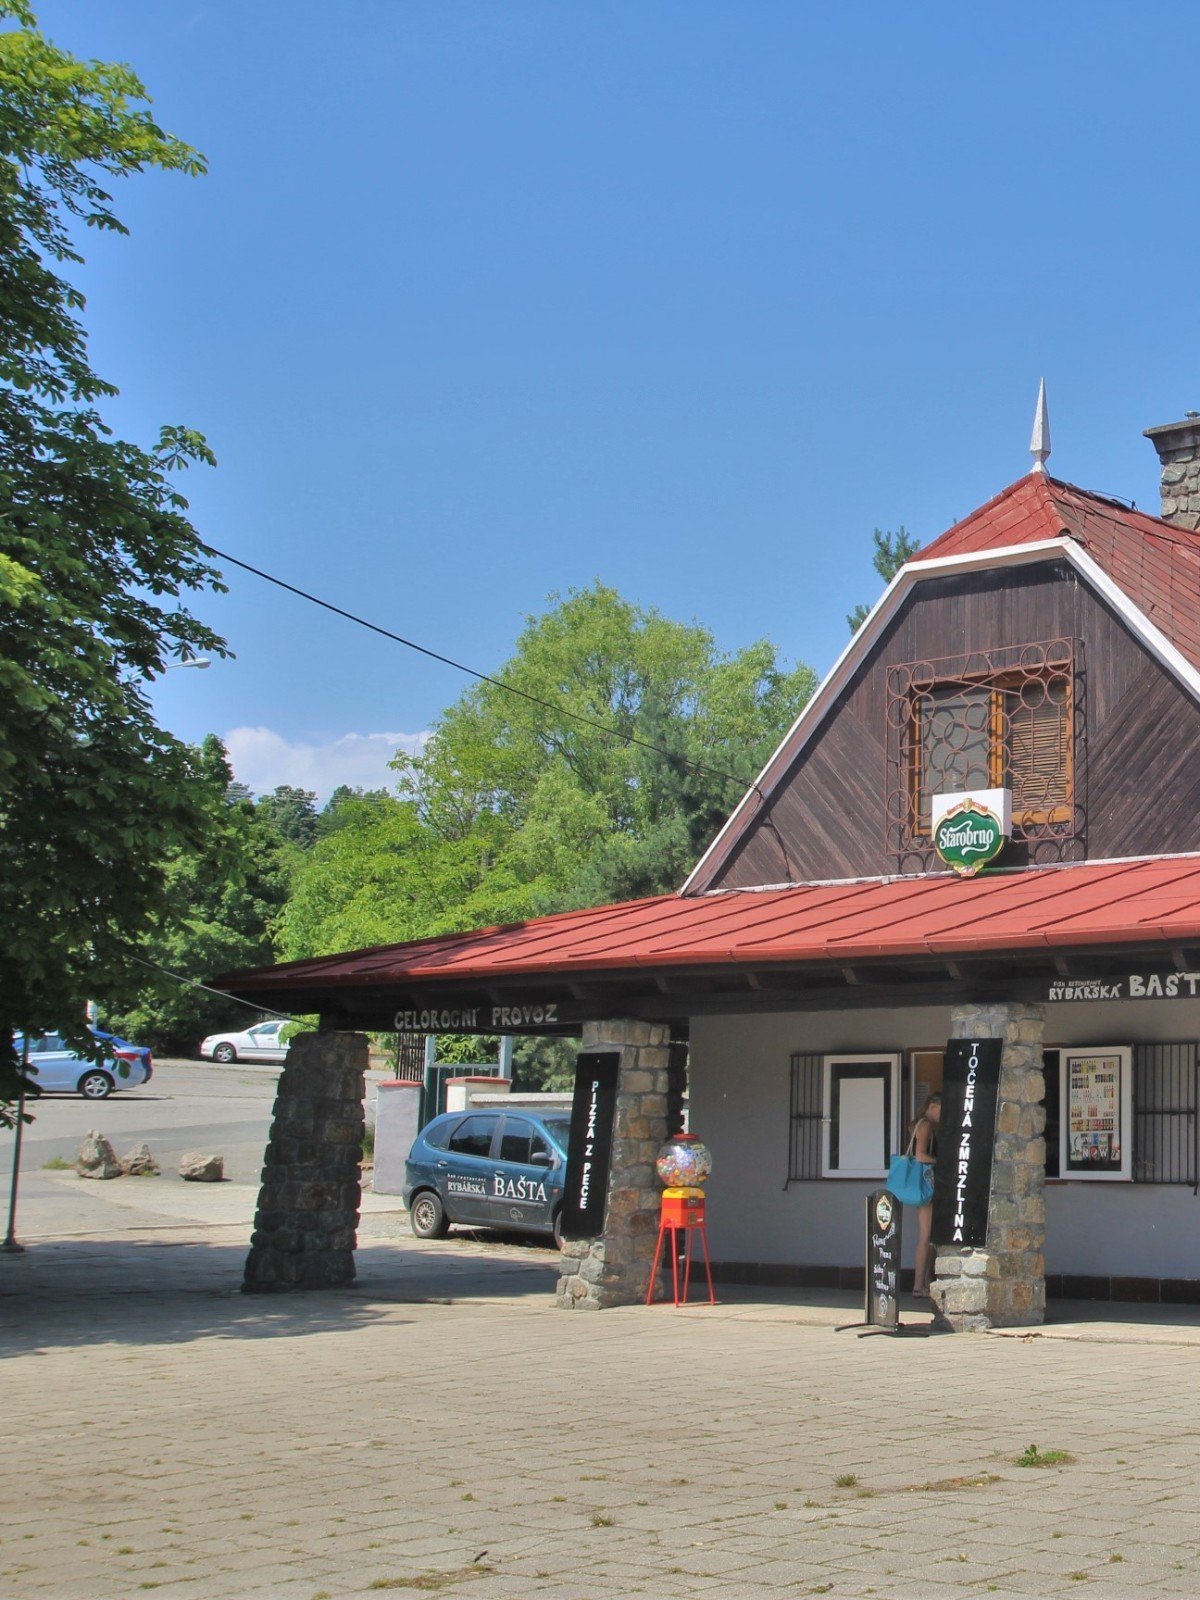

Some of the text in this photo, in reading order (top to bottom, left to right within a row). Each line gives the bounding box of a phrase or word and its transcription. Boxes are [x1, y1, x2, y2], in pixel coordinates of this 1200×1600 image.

[939, 820, 994, 856] Starobrno
[492, 1004, 558, 1026] PROVOZ
[580, 1081, 599, 1209] PIZZA Z PECE
[953, 1043, 979, 1241] TOČENÁ ZMRZLINA
[447, 1175, 548, 1201] RYBÁŘSKÁ BAŠTA
